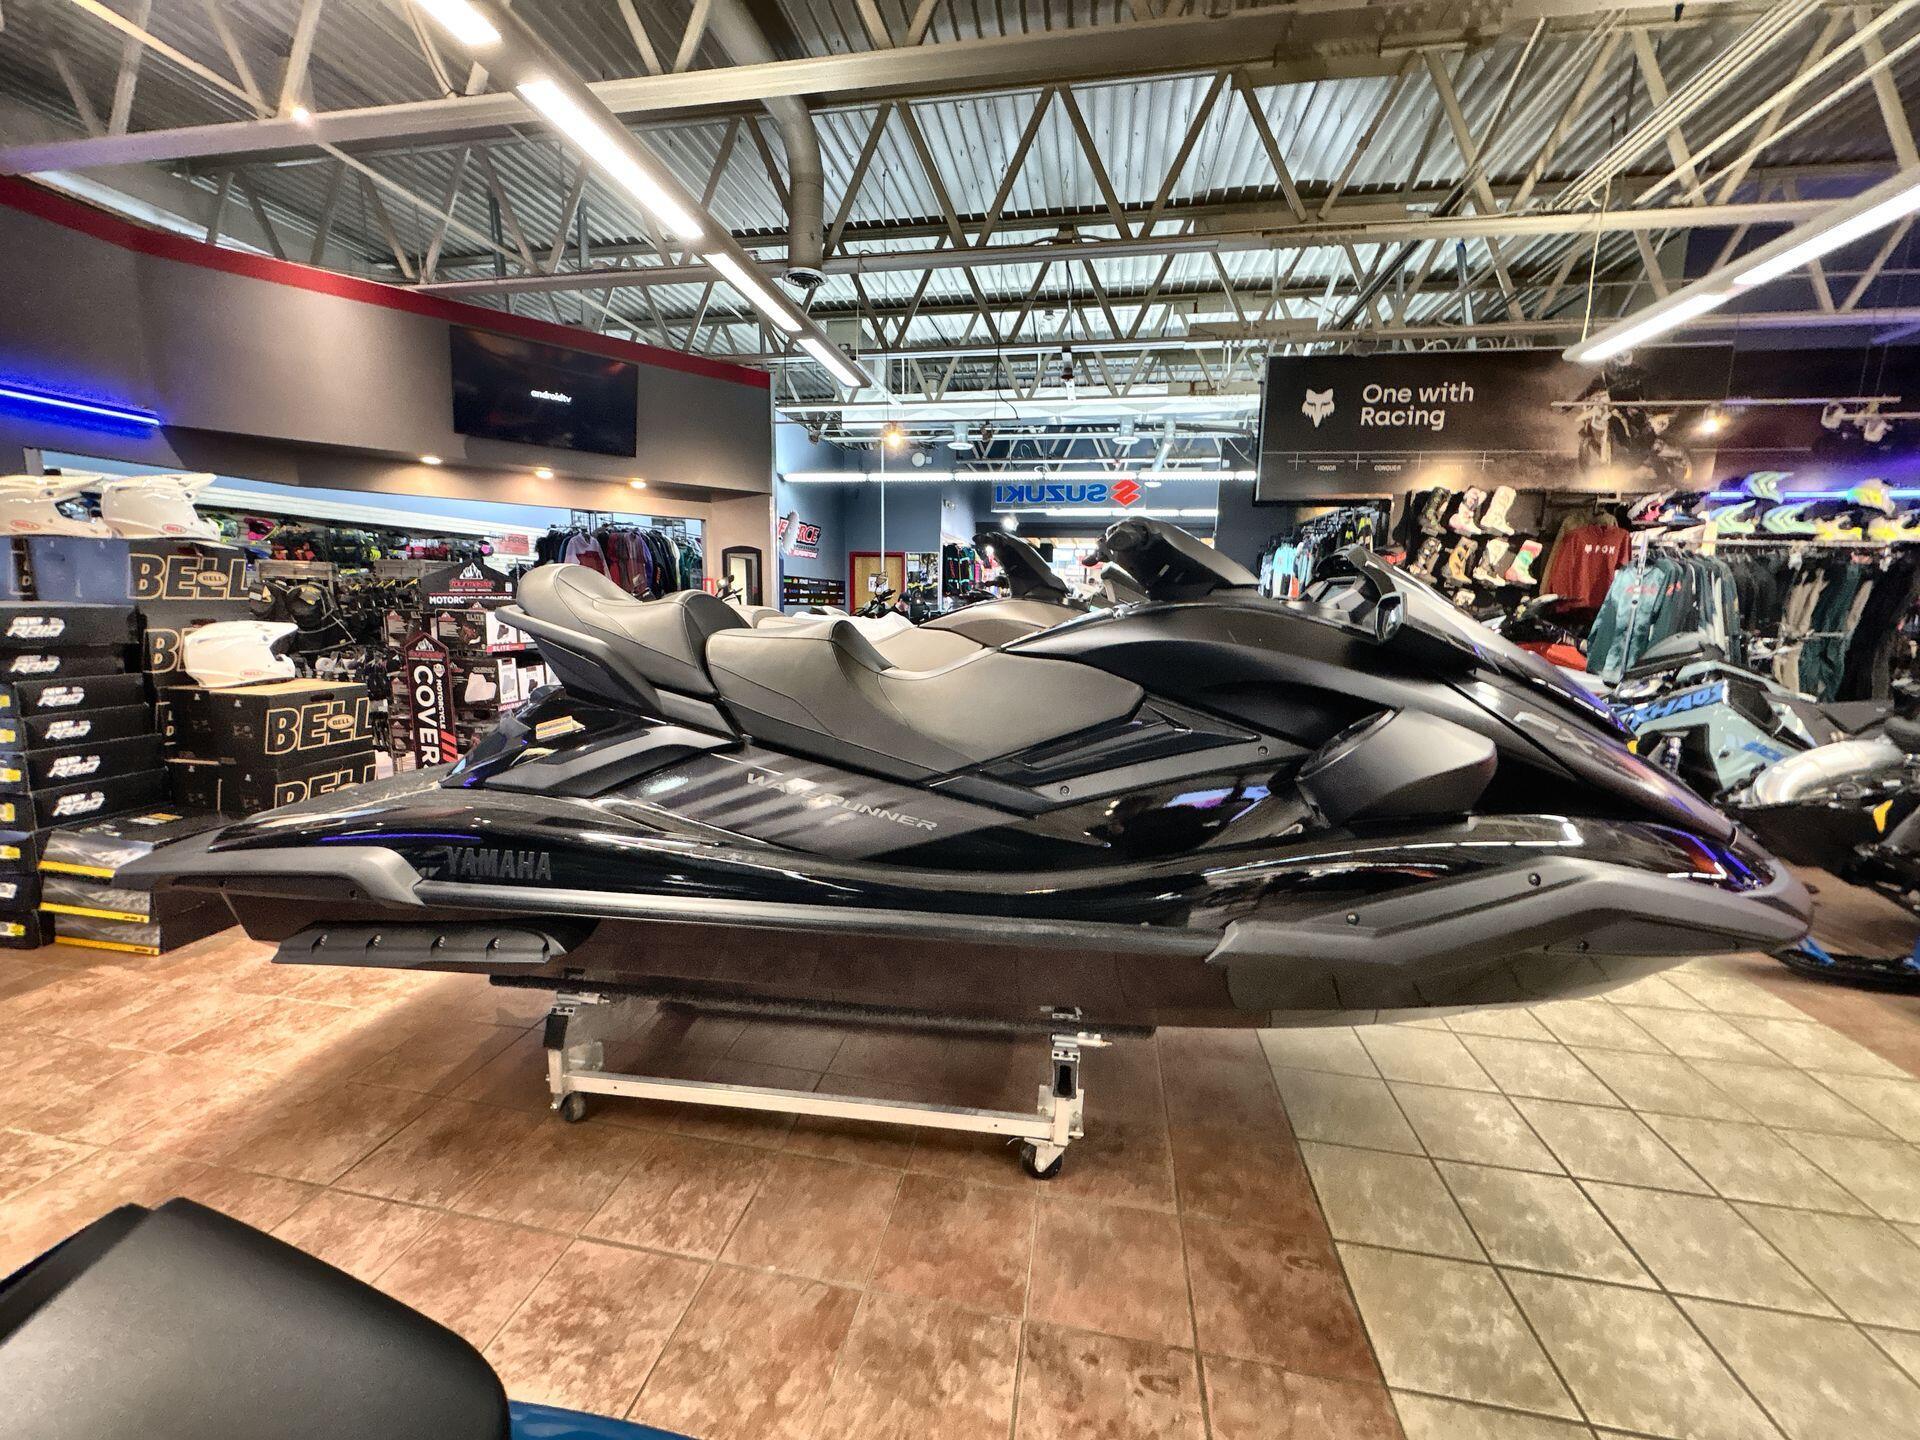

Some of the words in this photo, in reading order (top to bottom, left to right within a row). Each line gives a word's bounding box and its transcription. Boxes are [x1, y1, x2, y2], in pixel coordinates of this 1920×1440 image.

[1362, 383, 1413, 404] One
[1418, 381, 1475, 403] with
[1360, 405, 1446, 431] Racing
[128, 553, 250, 600] BELL
[265, 697, 373, 755] BELL
[413, 665, 440, 769] COVER
[435, 679, 446, 729] MOTORCYCLE
[445, 846, 552, 880] YAMAHA
